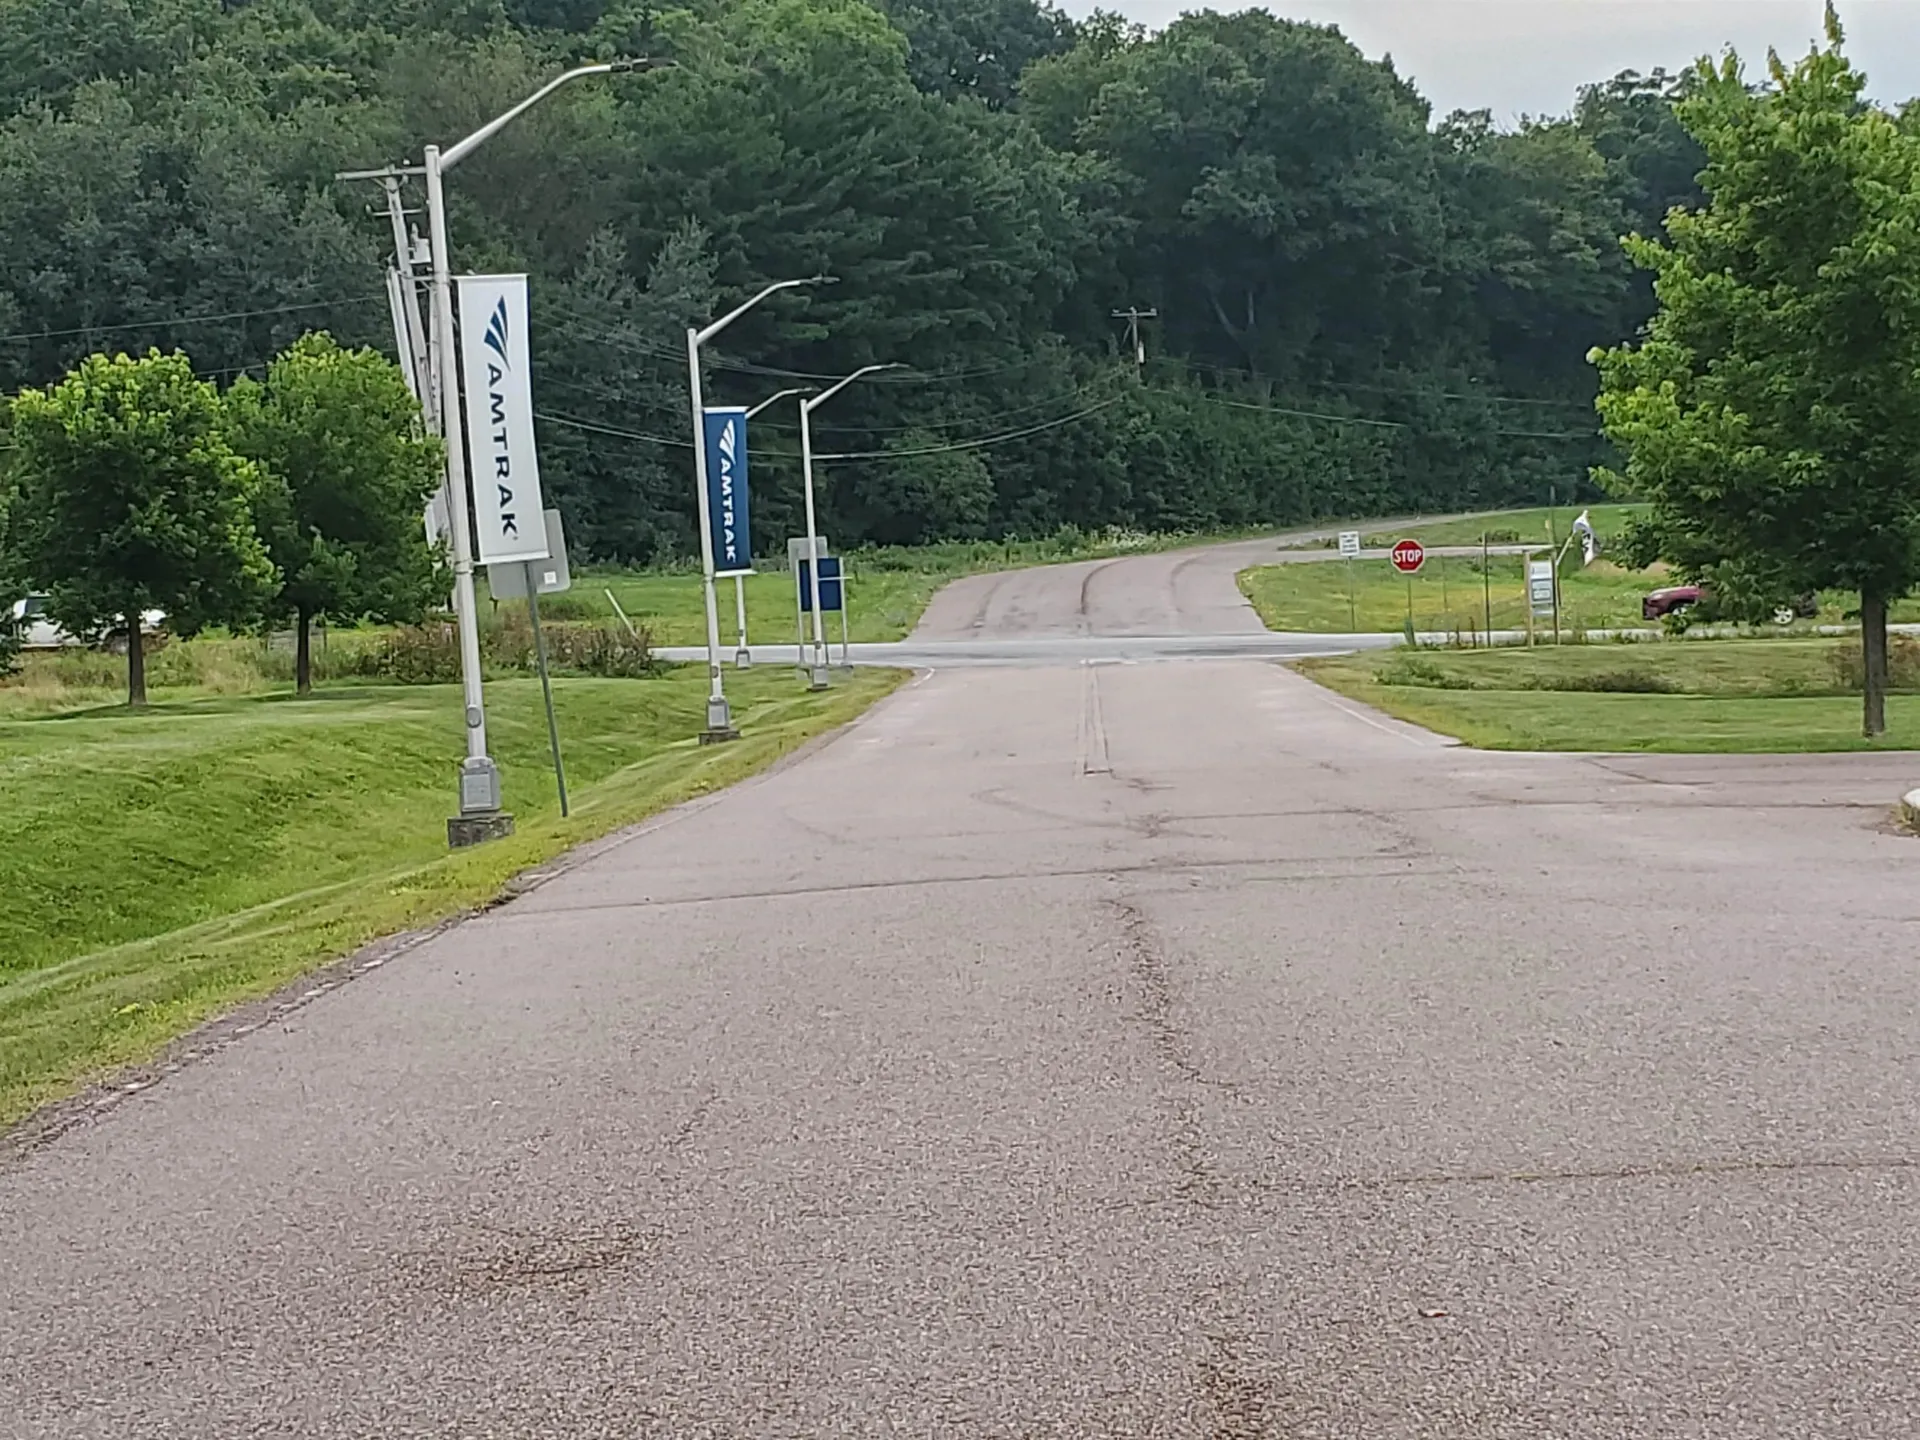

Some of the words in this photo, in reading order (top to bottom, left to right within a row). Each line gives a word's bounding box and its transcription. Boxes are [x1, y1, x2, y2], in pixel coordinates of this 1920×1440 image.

[487, 362, 518, 537] AMTRAK
[720, 457, 736, 563] AMTRAK
[1394, 549, 1421, 563] STOP
